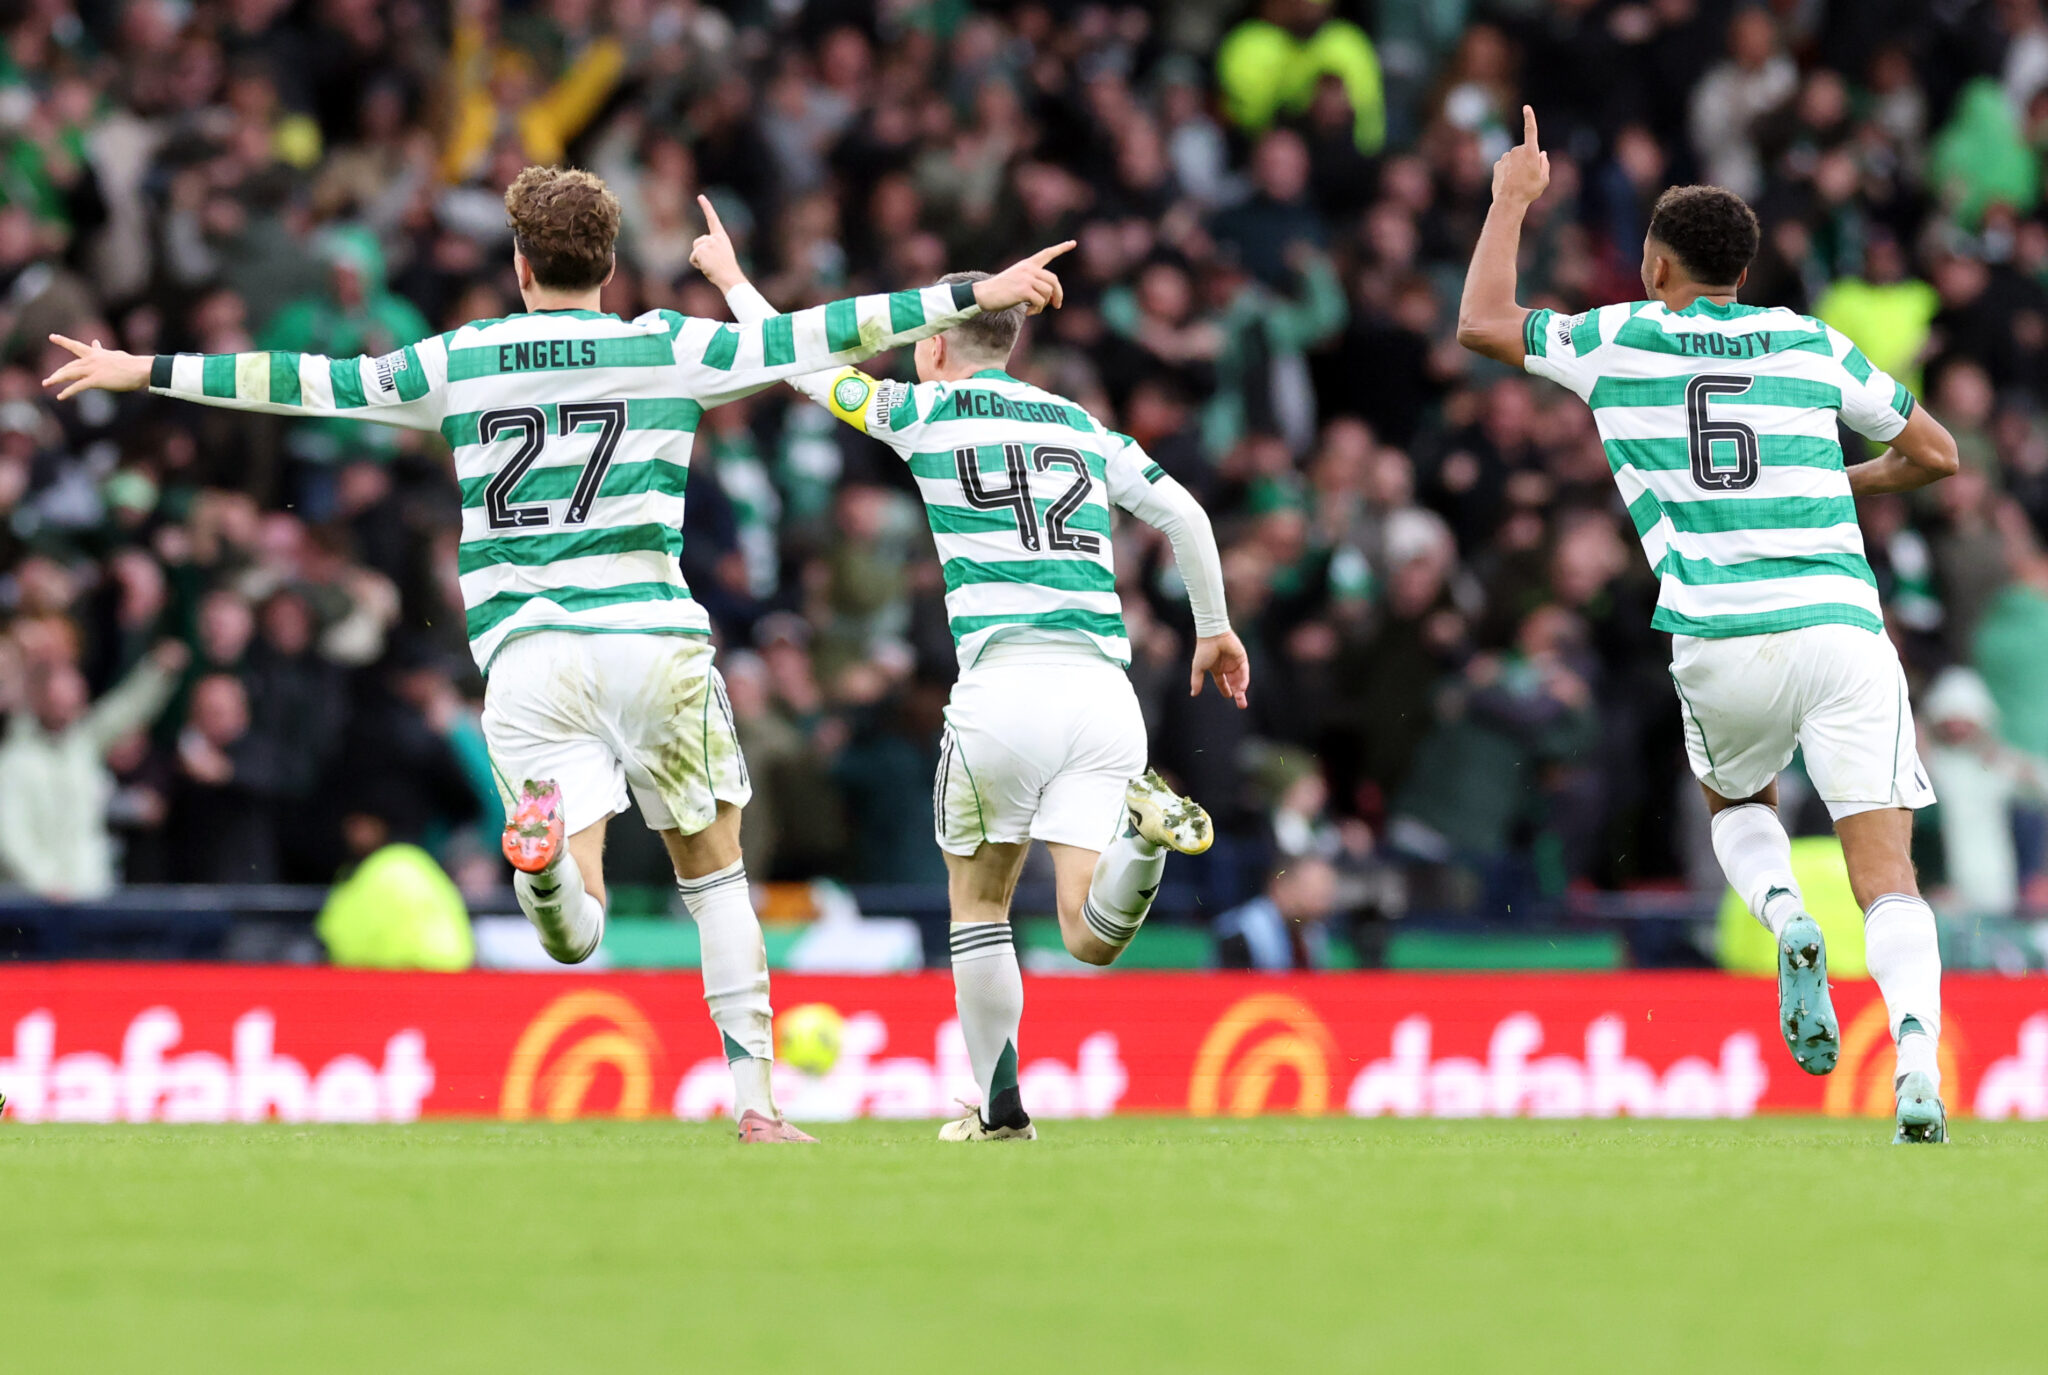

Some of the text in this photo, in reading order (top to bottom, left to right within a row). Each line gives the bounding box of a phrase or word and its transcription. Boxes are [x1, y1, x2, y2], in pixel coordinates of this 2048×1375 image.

[499, 339, 596, 373] ENGELS
[1675, 332, 1772, 357] TRUSTY
[477, 399, 629, 531] 27
[1684, 372, 1761, 493] 6
[953, 442, 1102, 557] 42
